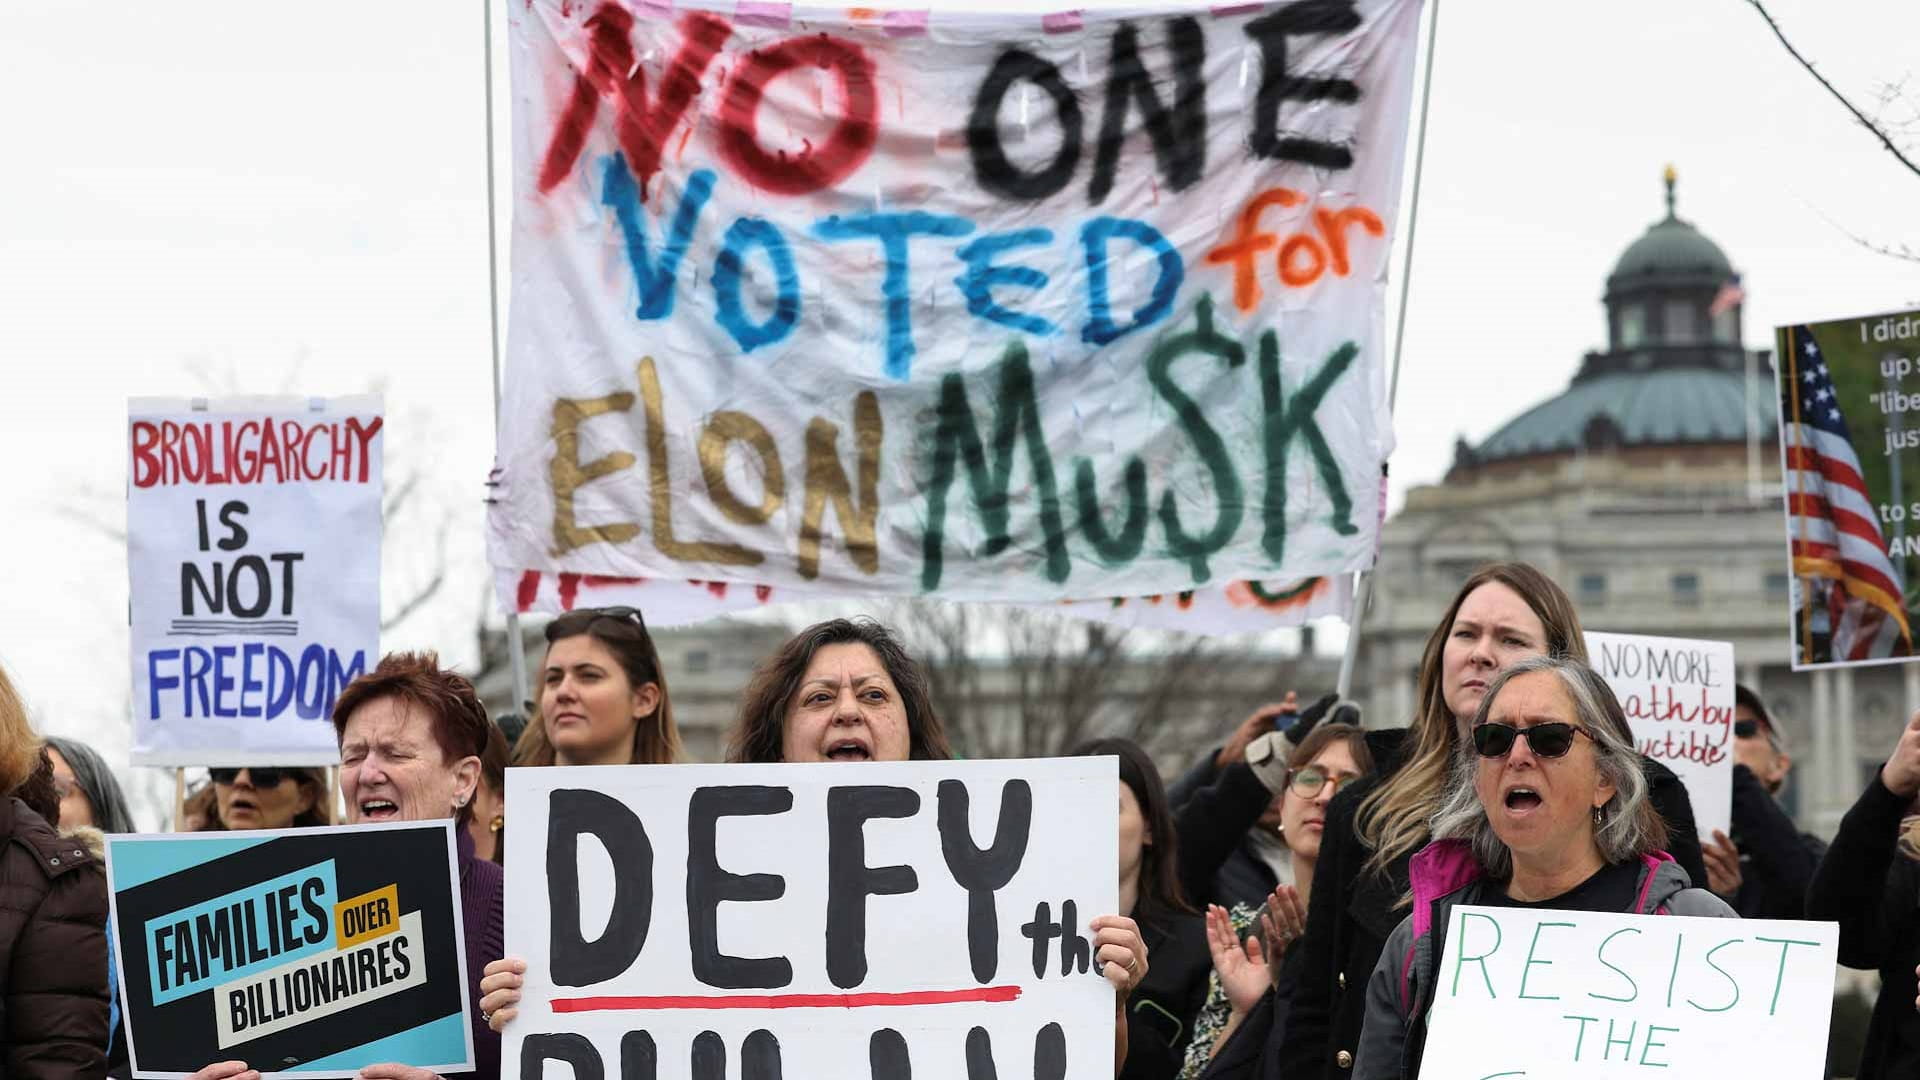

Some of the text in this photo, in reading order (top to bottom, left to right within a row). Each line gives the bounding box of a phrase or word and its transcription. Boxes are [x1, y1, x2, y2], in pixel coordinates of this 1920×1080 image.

[537, 0, 1362, 205] NO ONE
[601, 151, 1384, 379] VOTED for
[1861, 321, 1868, 342] I
[1881, 358, 1911, 381] up
[132, 416, 384, 488] BROLIGARCHY
[548, 355, 883, 581] ELON
[1884, 427, 1920, 455] jus
[196, 499, 249, 551] IS
[1880, 503, 1906, 522] to
[181, 553, 304, 618] NOT
[1602, 642, 1720, 687] NO MORE
[1703, 688, 1731, 746] by
[546, 779, 1032, 989] DEFY
[155, 877, 391, 991] FAMILIES OVER
[1452, 913, 1820, 1015] RESIST
[229, 935, 411, 1033] BILLIONAIRES
[1563, 1016, 1680, 1066] THE
